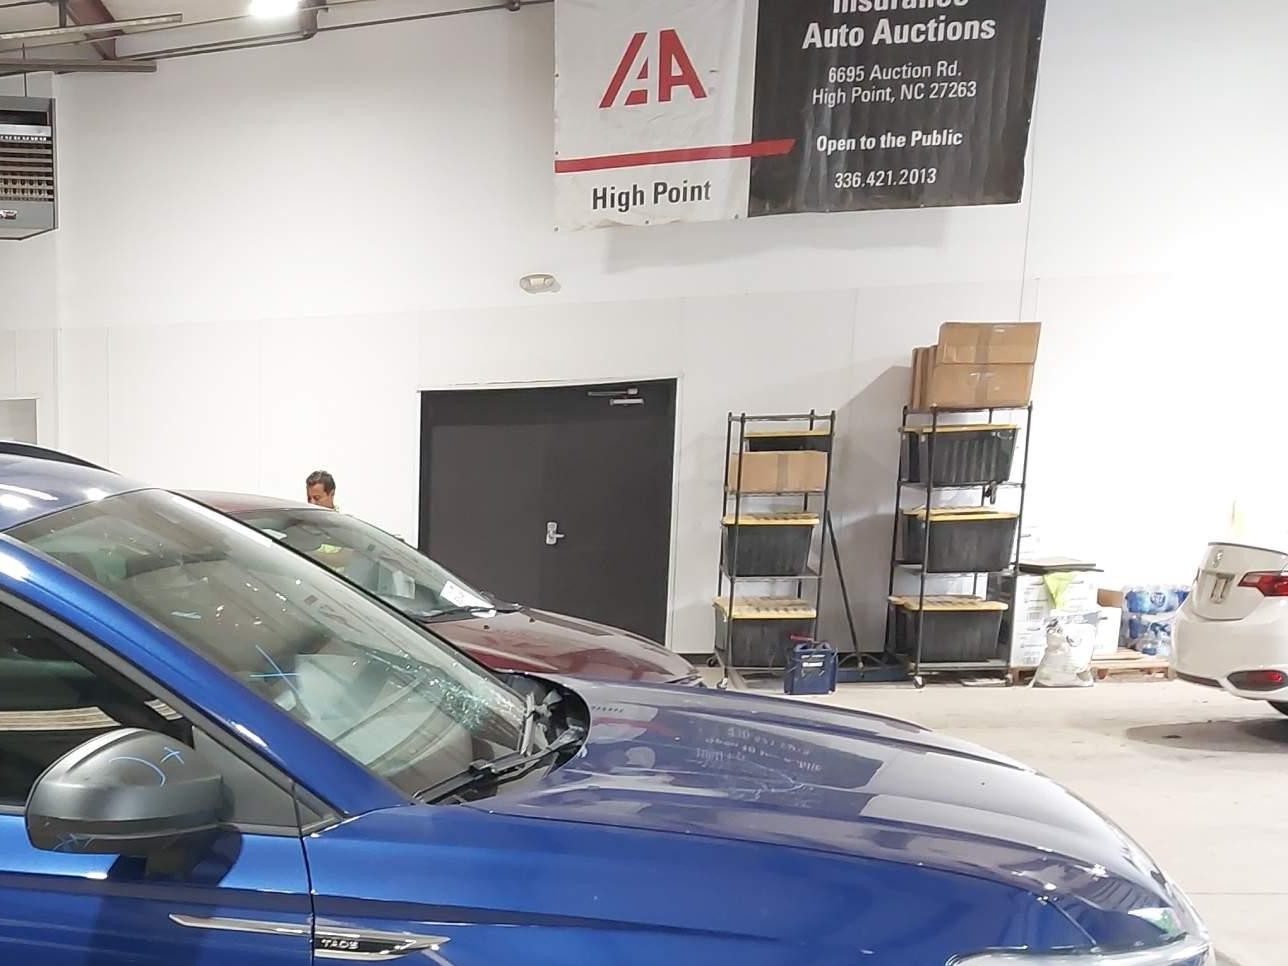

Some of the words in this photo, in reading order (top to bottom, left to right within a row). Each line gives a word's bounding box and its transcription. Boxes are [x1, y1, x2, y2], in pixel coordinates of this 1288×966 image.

[802, 23, 864, 49] Auto
[871, 15, 996, 45] Auctions
[828, 66, 864, 83] 6695
[869, 62, 932, 81] Auction
[937, 60, 962, 77] Rd.
[812, 88, 846, 108] High
[851, 86, 896, 104] Point,
[900, 83, 925, 101] NC
[929, 80, 977, 99] 27263
[816, 135, 856, 156] Open
[860, 136, 876, 150] to
[880, 132, 906, 148] the
[910, 129, 963, 147] Public
[834, 168, 937, 189] 336.421.2013
[592, 184, 645, 213] High
[653, 180, 712, 205] Point
